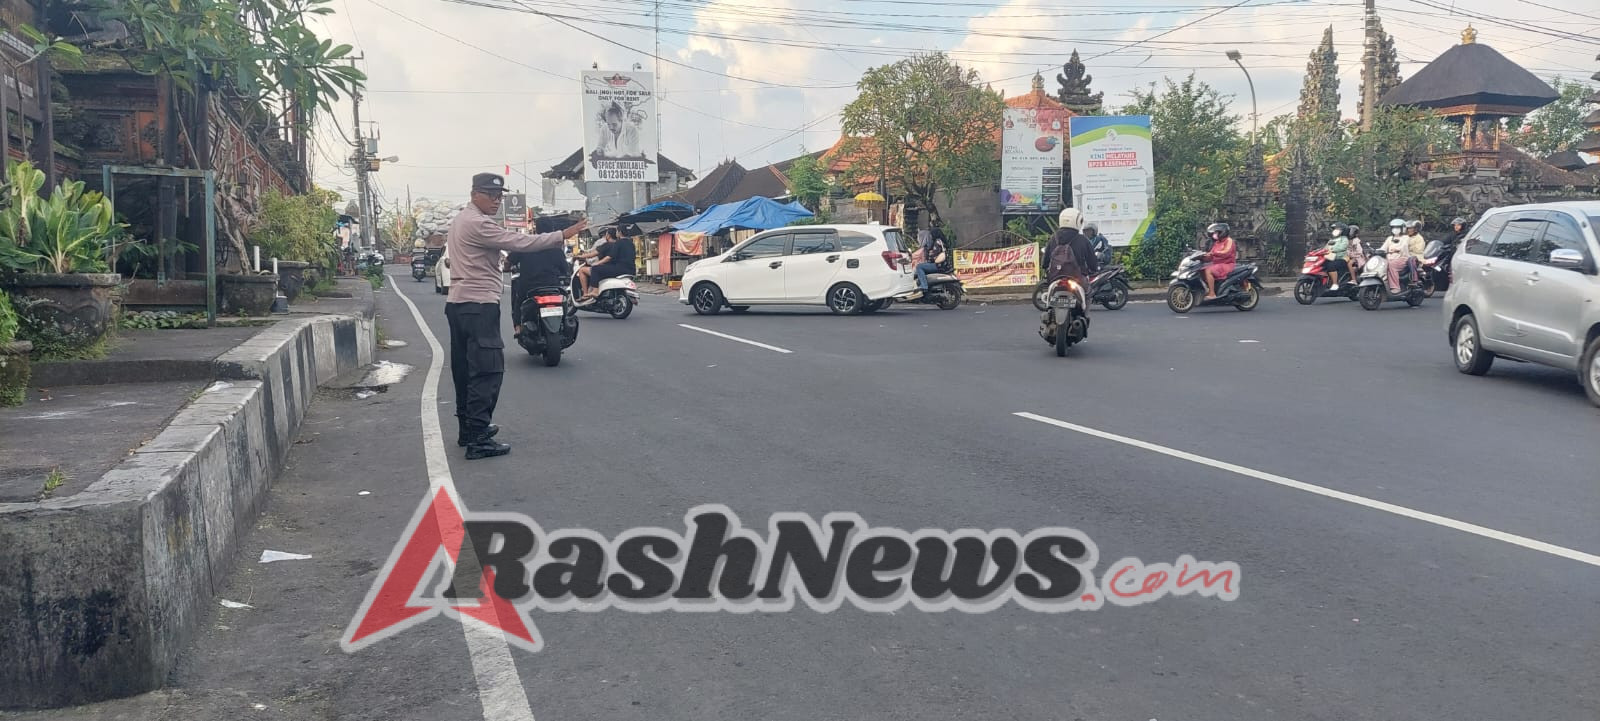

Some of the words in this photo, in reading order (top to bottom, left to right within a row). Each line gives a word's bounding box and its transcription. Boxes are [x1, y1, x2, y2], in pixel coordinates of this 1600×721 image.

[598, 161, 615, 170] SPACE
[616, 161, 644, 170] AVAILABLE
[972, 249, 1021, 265] WASPADA
